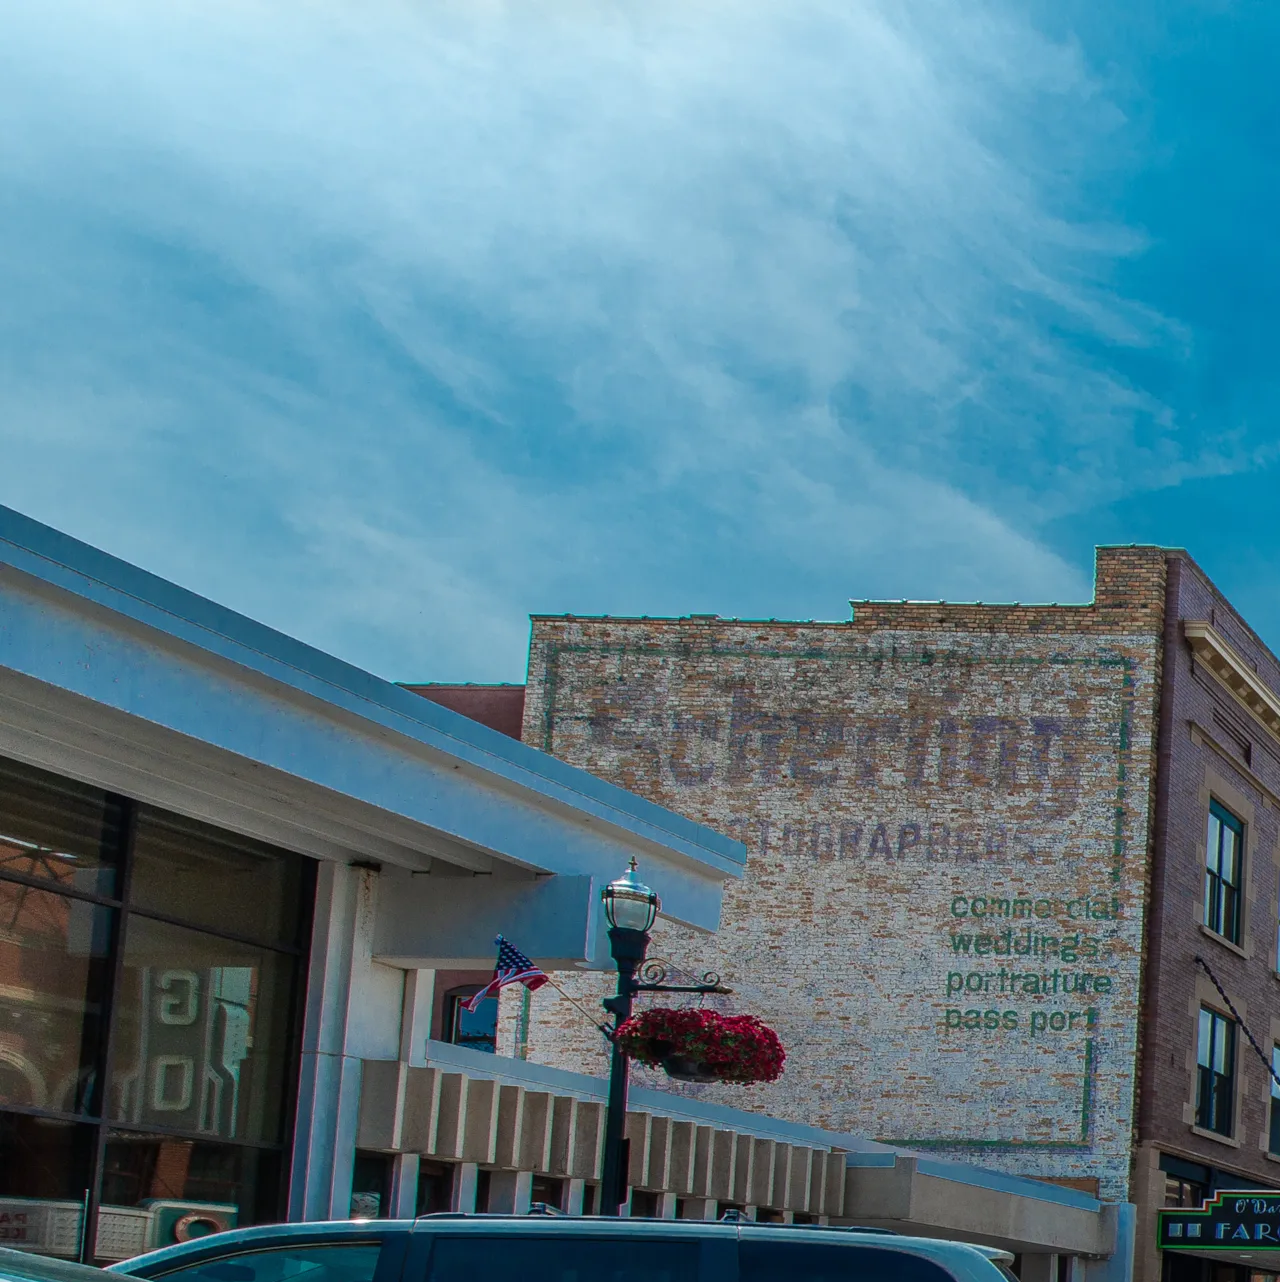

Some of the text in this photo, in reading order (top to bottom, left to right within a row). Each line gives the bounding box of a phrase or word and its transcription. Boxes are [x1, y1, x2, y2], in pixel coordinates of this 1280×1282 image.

[950, 894, 1120, 920] commecial
[950, 929, 1100, 963] weddings
[946, 967, 1112, 998] portraiture
[945, 1006, 1098, 1037] pass port
